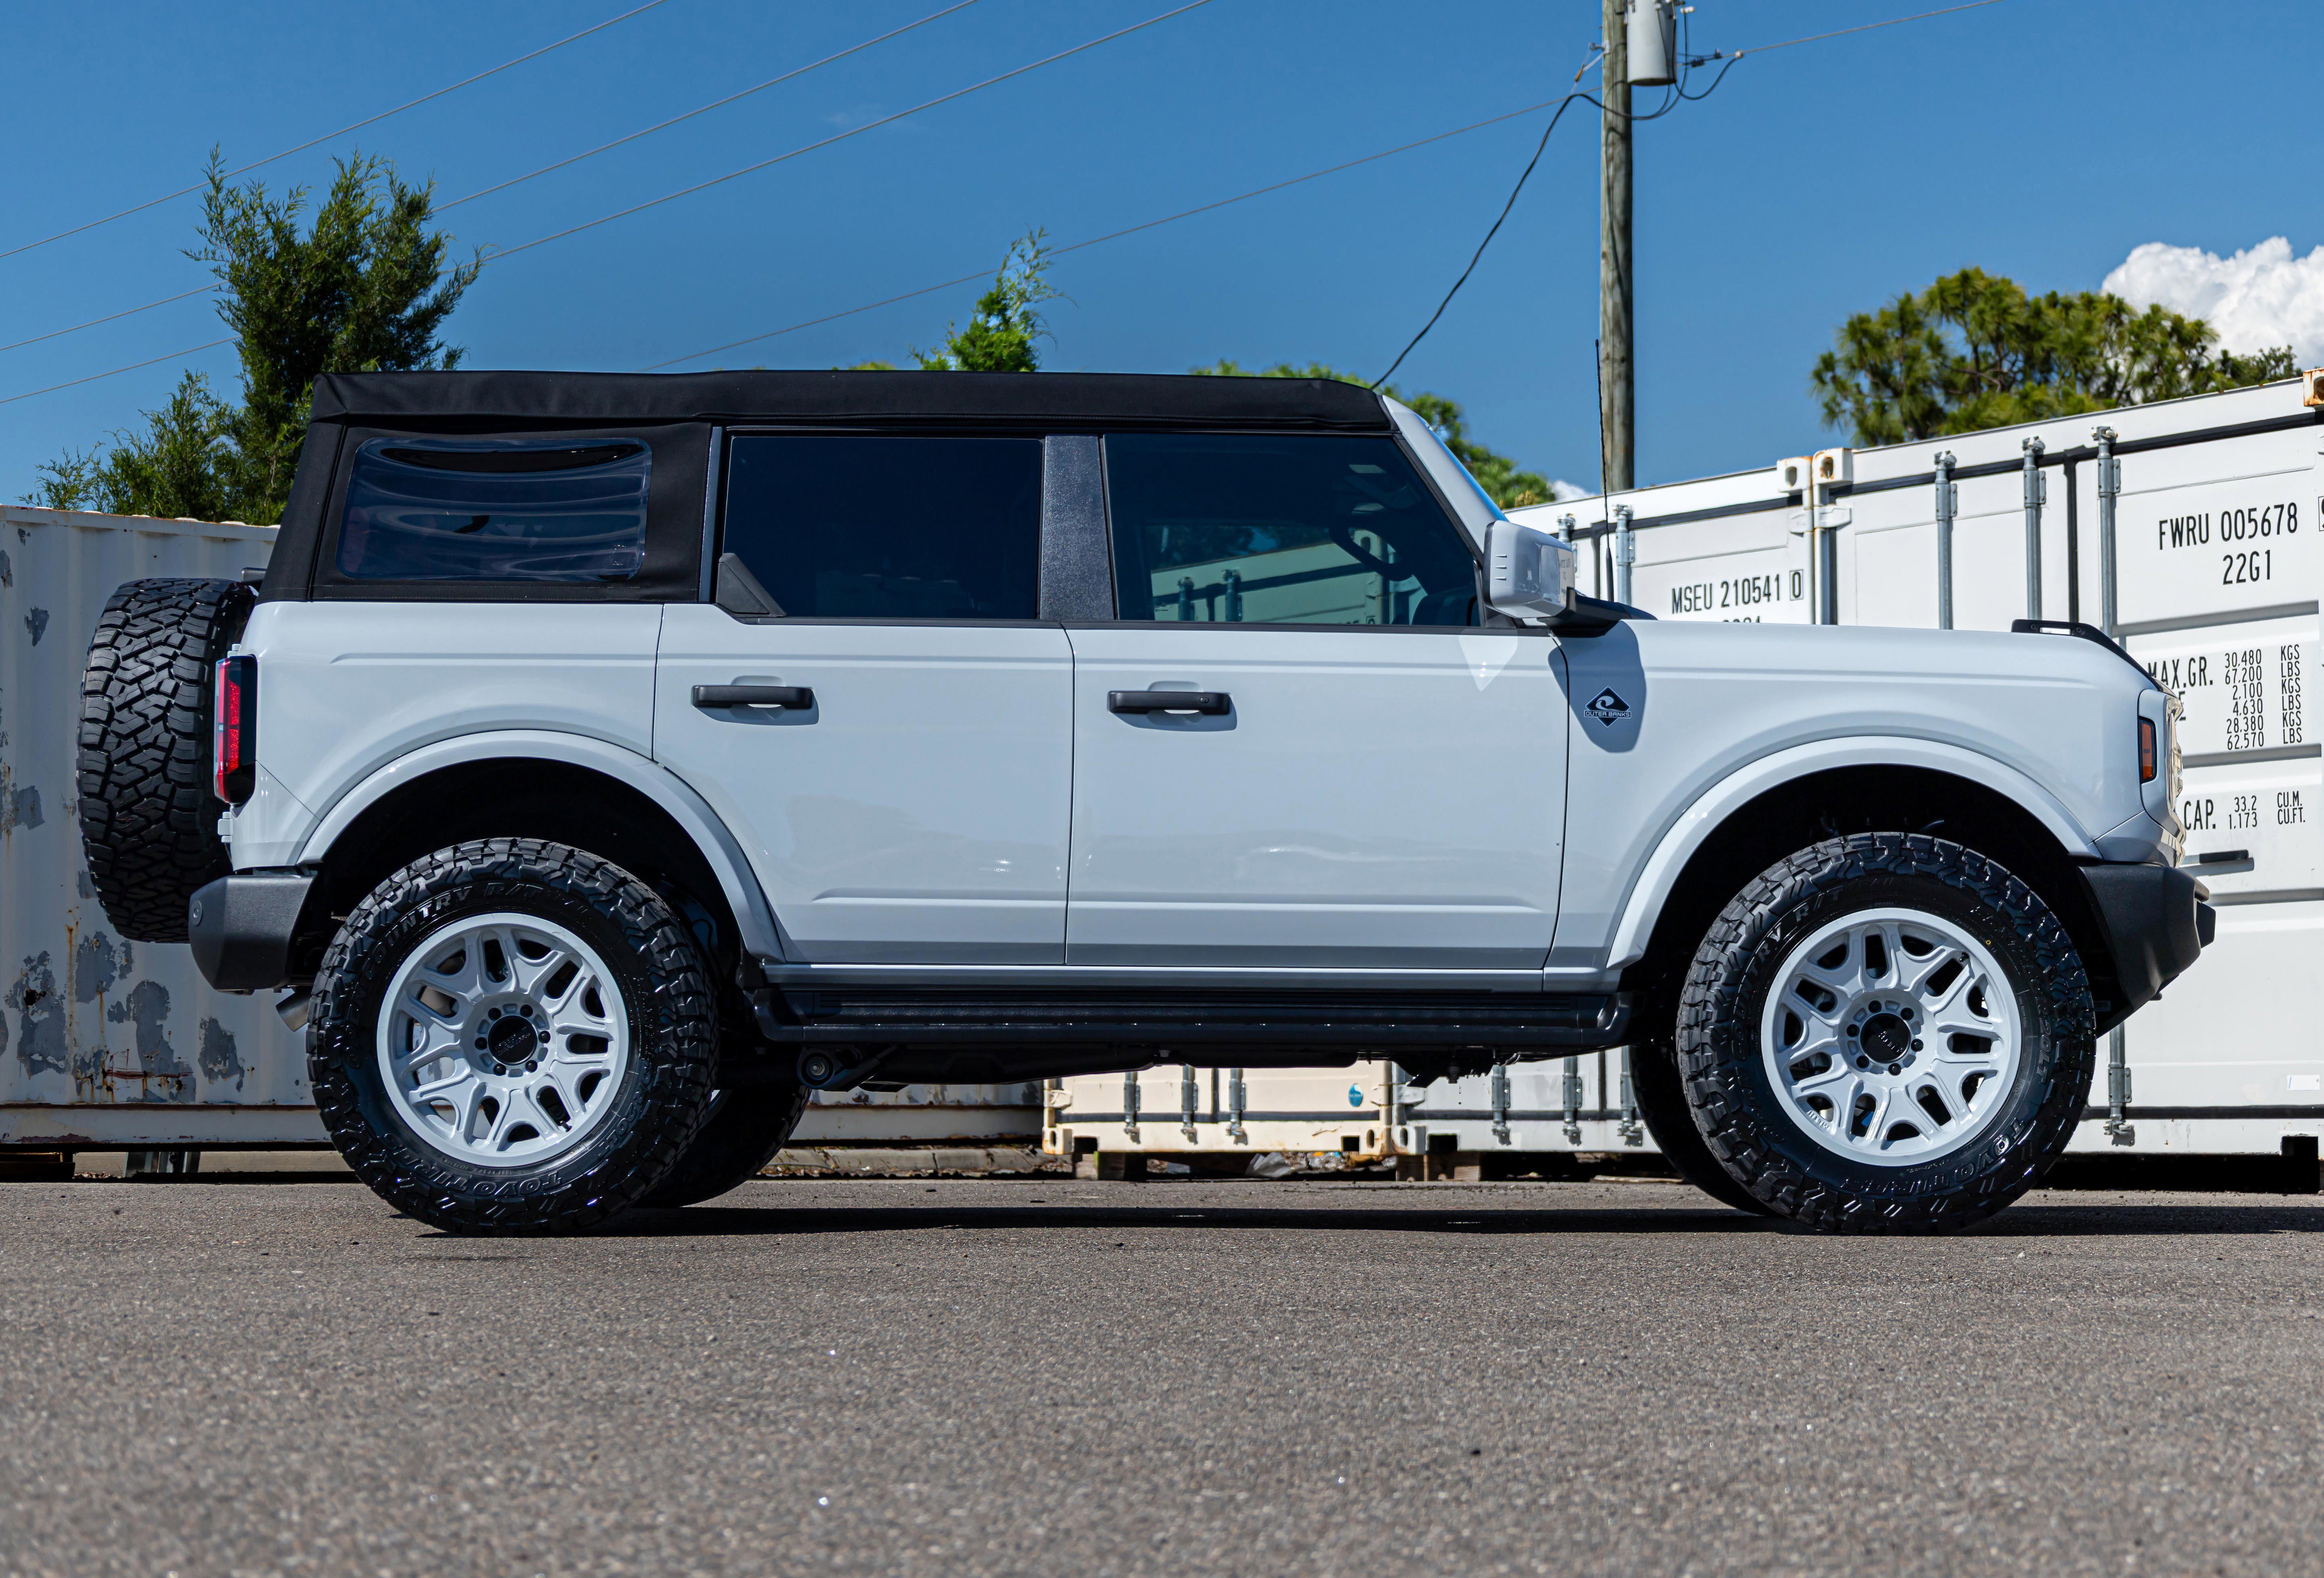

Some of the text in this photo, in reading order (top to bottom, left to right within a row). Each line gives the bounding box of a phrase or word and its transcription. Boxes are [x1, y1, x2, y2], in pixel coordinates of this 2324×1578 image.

[2159, 513, 2209, 550] FWRU
[2221, 502, 2297, 542] 005678
[2223, 549, 2270, 585] 22G1
[1672, 583, 1712, 614] MSEU
[1721, 574, 1780, 607] 210541
[2225, 644, 2300, 668] 30,480 KGS
[2225, 661, 2300, 685] 67,200 LBS
[2232, 677, 2301, 700] 2,100 KGS
[2232, 694, 2301, 717] 4,630 LBS
[2226, 710, 2301, 734] 28,380 KGS
[2227, 727, 2302, 751] 62,570 LBS
[2183, 799, 2216, 831] CAP.
[2234, 791, 2303, 813] 33.2 CU.M.
[2228, 807, 2306, 830] 1,173 CU.FT.
[364, 884, 474, 974] COUNTRY
[1732, 924, 1783, 1061] COUNTRY
[1794, 885, 1845, 923] R/T
[1954, 1116, 2028, 1178] TOYO
[473, 1171, 563, 1199] TOYO
